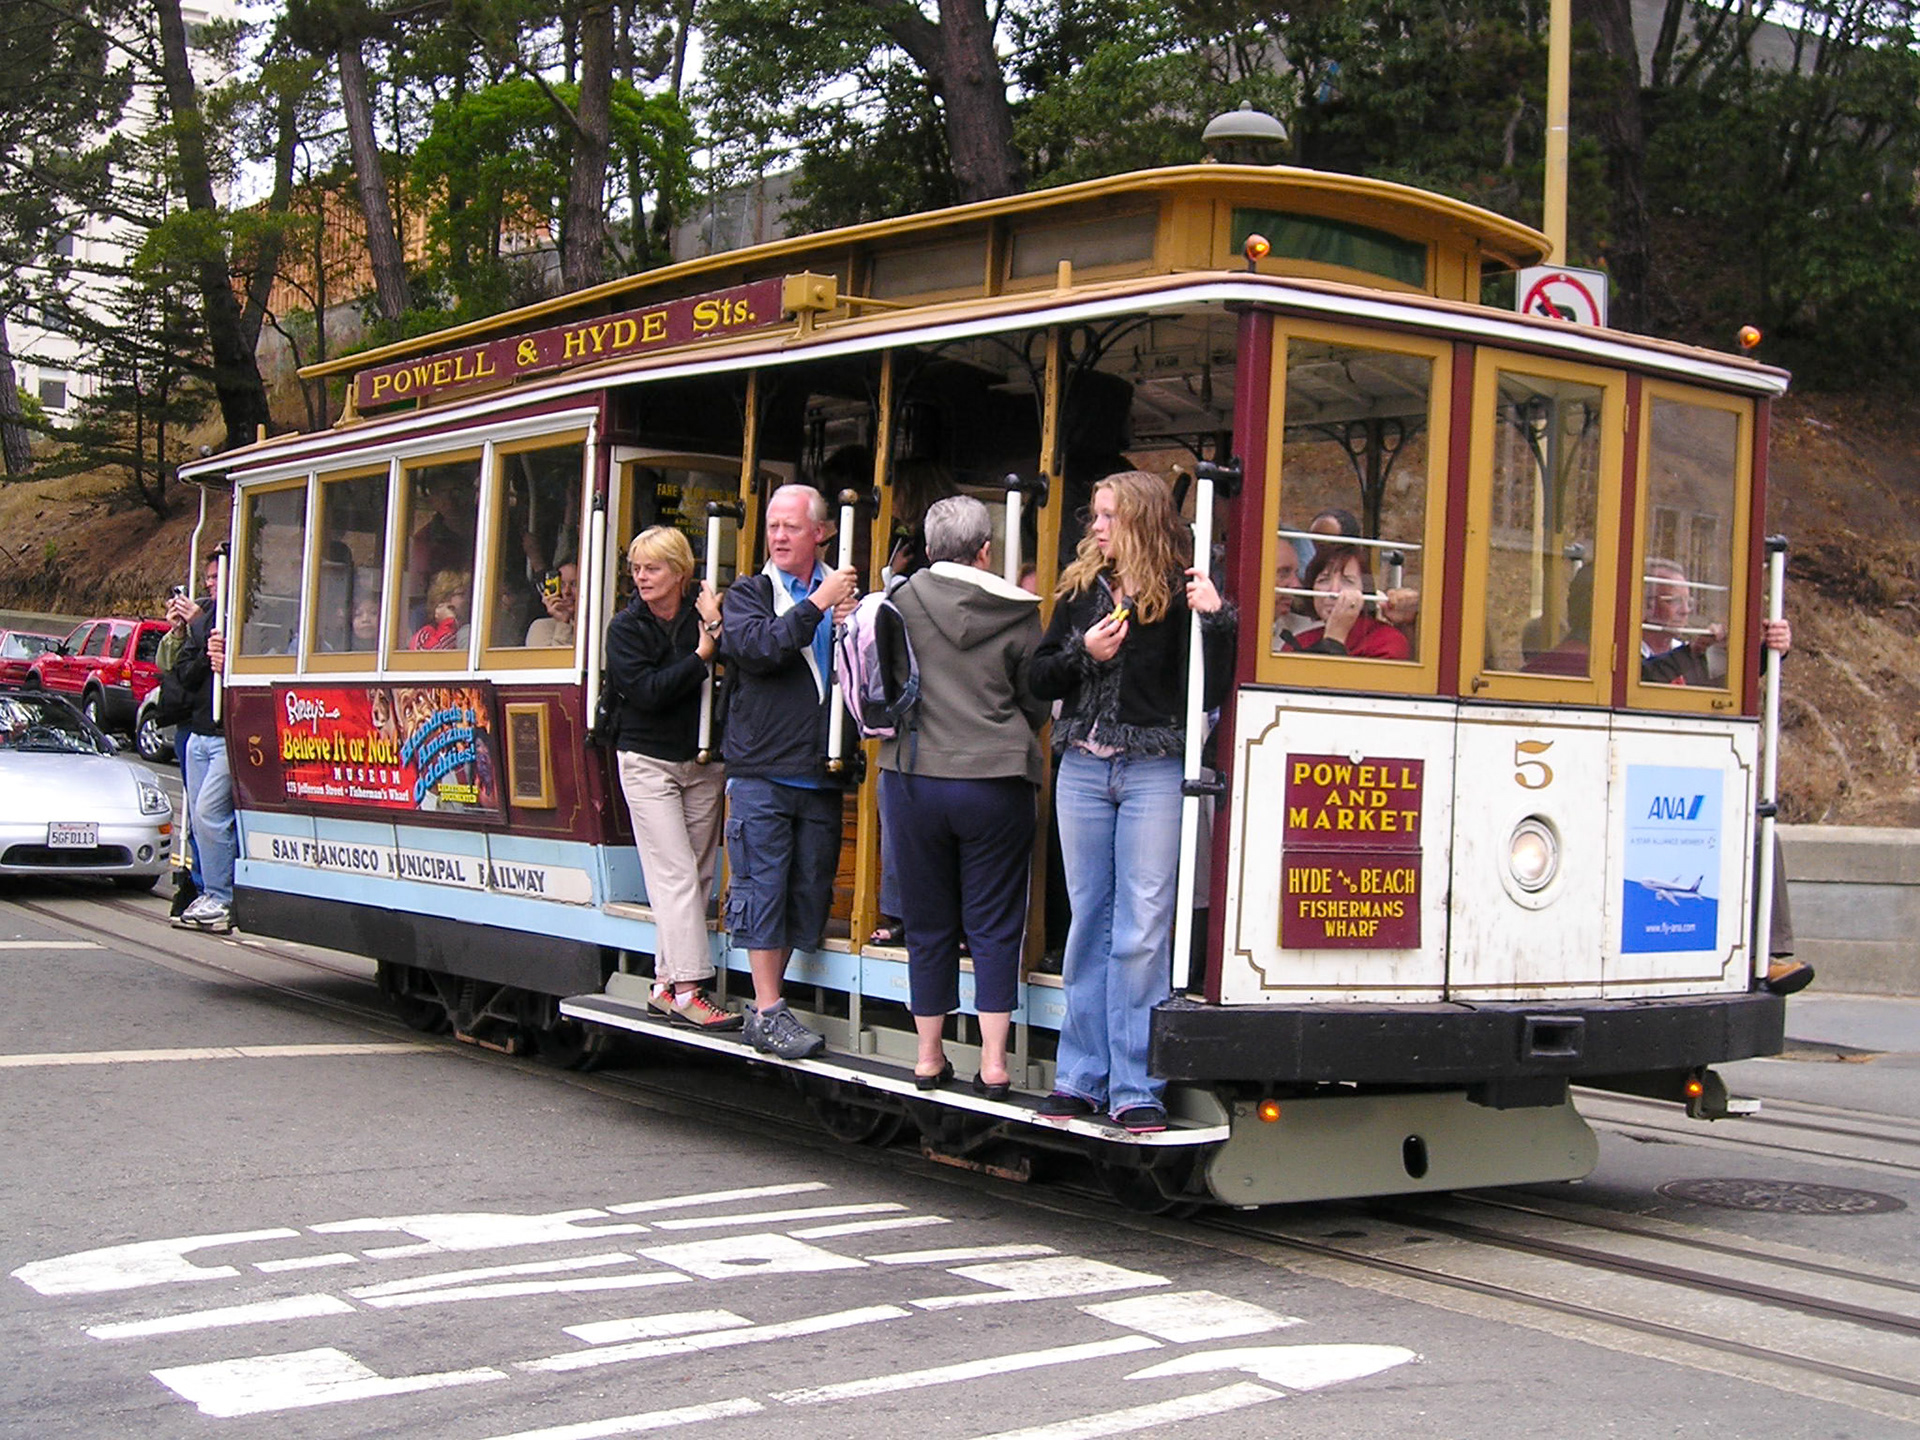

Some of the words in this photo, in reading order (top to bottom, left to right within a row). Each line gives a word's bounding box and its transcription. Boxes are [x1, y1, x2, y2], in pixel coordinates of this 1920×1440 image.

[371, 351, 496, 400] POWELL
[516, 338, 539, 366] &
[562, 311, 668, 360] HYDE
[692, 298, 757, 332] Sts.
[656, 483, 678, 497] FARE
[283, 728, 331, 760] Believe
[333, 729, 348, 762] It
[350, 737, 365, 763] or
[367, 729, 399, 765] Not!
[400, 701, 463, 768] Hundreds
[418, 722, 474, 770] Amazing
[248, 735, 264, 767] 5
[333, 766, 401, 785] MUSEUM
[413, 743, 477, 803] Oddities!
[1292, 762, 1418, 790] POWELL
[1514, 739, 1555, 790] 5
[296, 781, 325, 796] Jefferson
[324, 783, 345, 797] Street
[349, 785, 388, 801] Fisherman's
[387, 787, 410, 803] Wharf
[1325, 789, 1389, 808] AND
[1289, 807, 1419, 832] MARKET
[1647, 795, 1685, 820] ANA
[52, 831, 95, 845] 5GFD113
[272, 838, 300, 861] SAN
[302, 843, 379, 871] FRANCISCO
[1288, 868, 1333, 894] HYDE
[1336, 869, 1358, 893] AND
[1360, 868, 1416, 894] BEACH
[1299, 900, 1404, 918] FISHERMANS
[1324, 920, 1379, 938] WHARF
